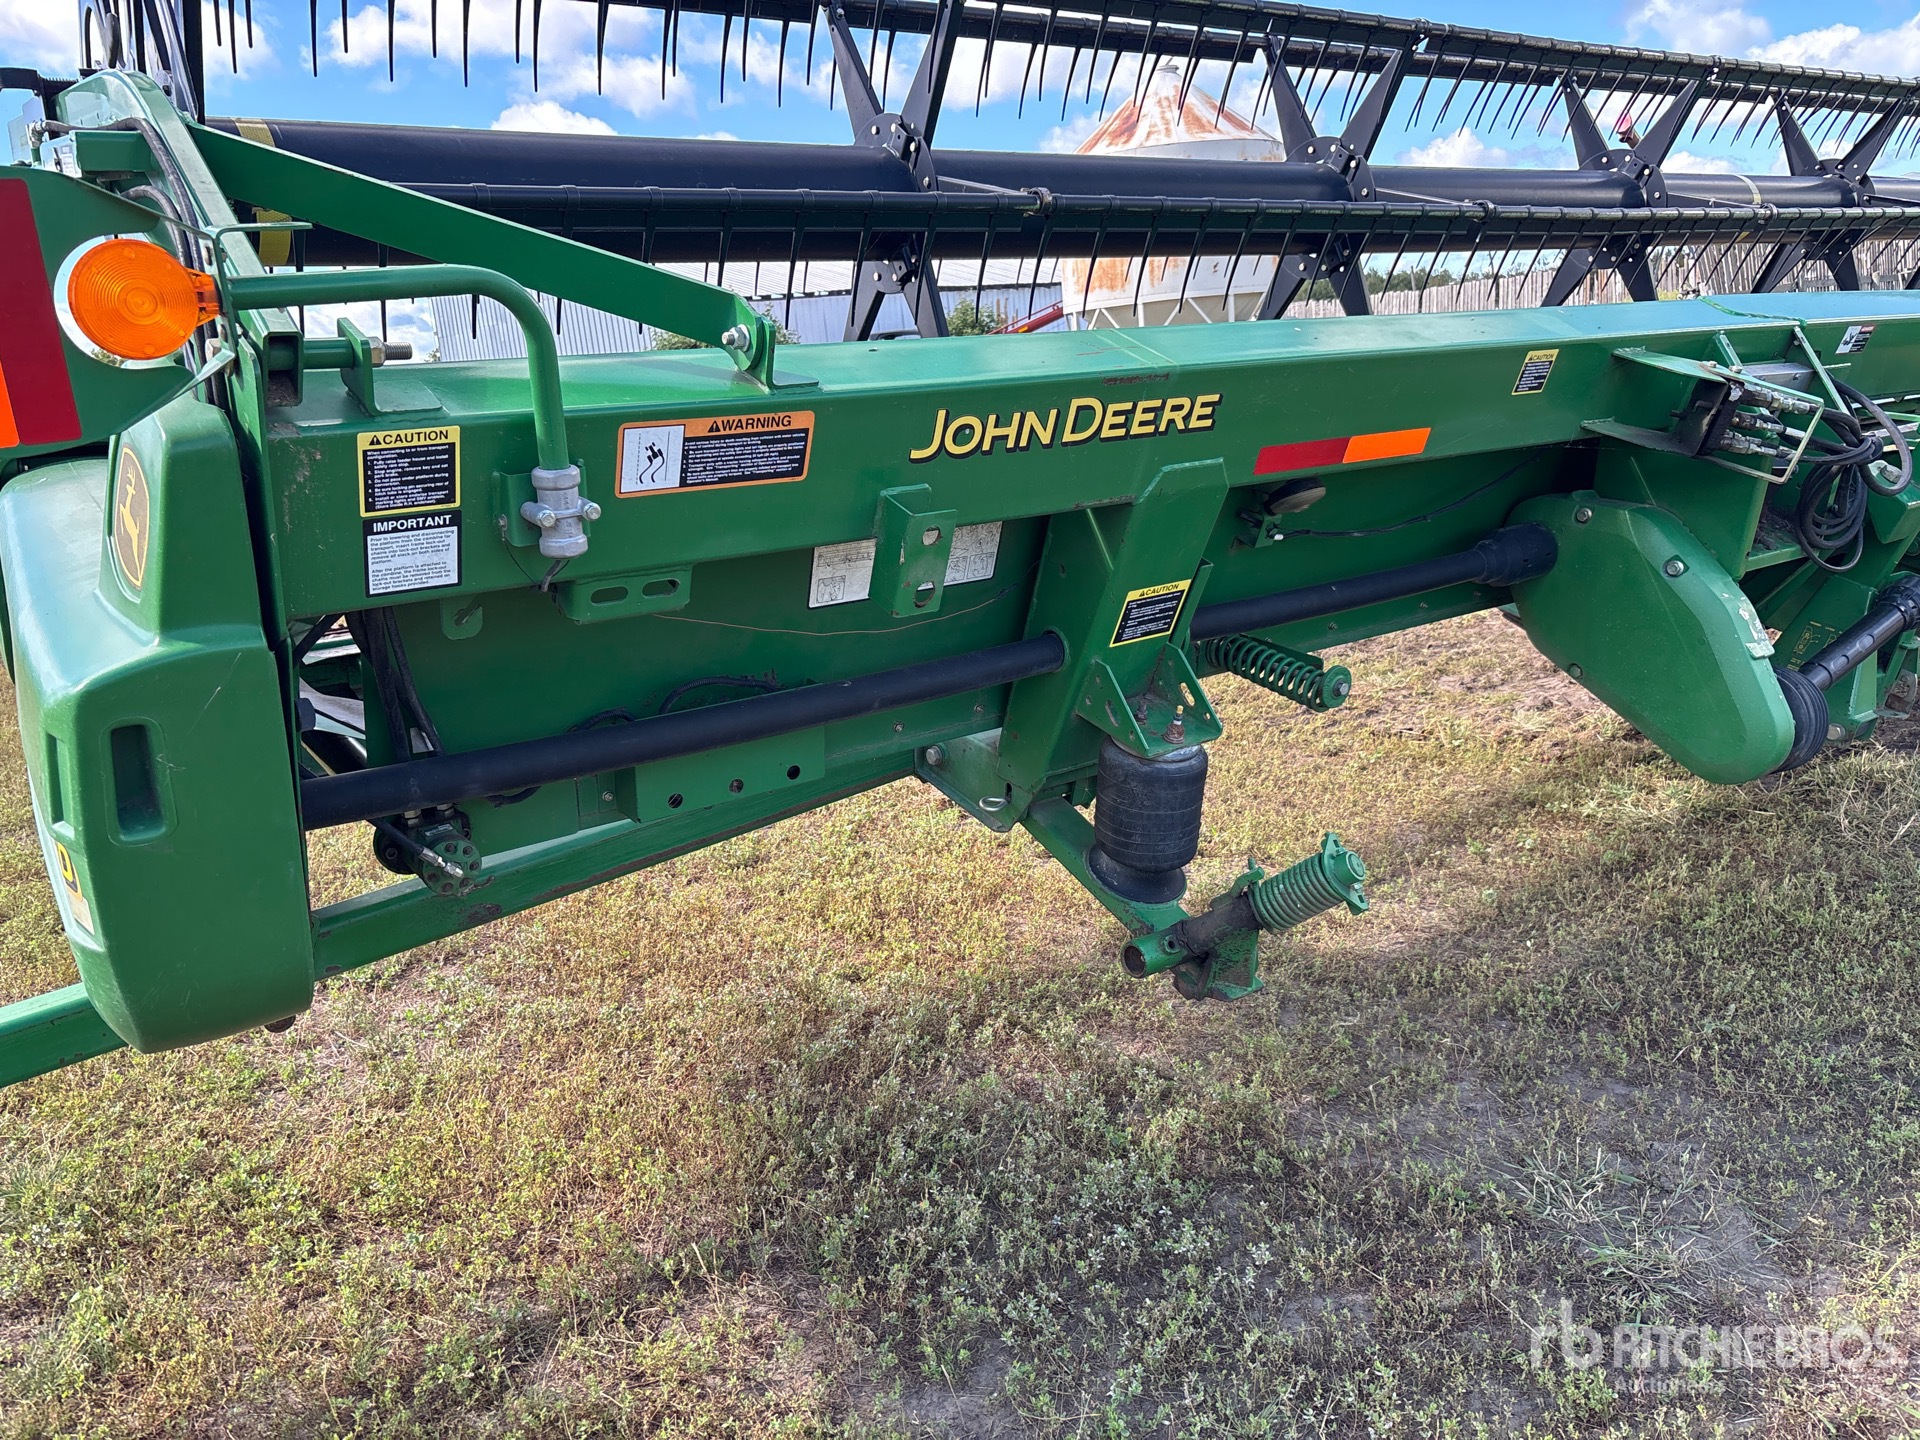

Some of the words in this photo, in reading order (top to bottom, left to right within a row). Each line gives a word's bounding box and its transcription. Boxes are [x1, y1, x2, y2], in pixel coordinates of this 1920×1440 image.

[721, 415, 792, 432] WARNING
[909, 408, 1060, 463] JOHN
[1061, 394, 1223, 447] DEERE
[383, 430, 448, 445] CAUTION
[373, 515, 452, 532] IMPORTANT
[1146, 584, 1179, 596] CAUTION
